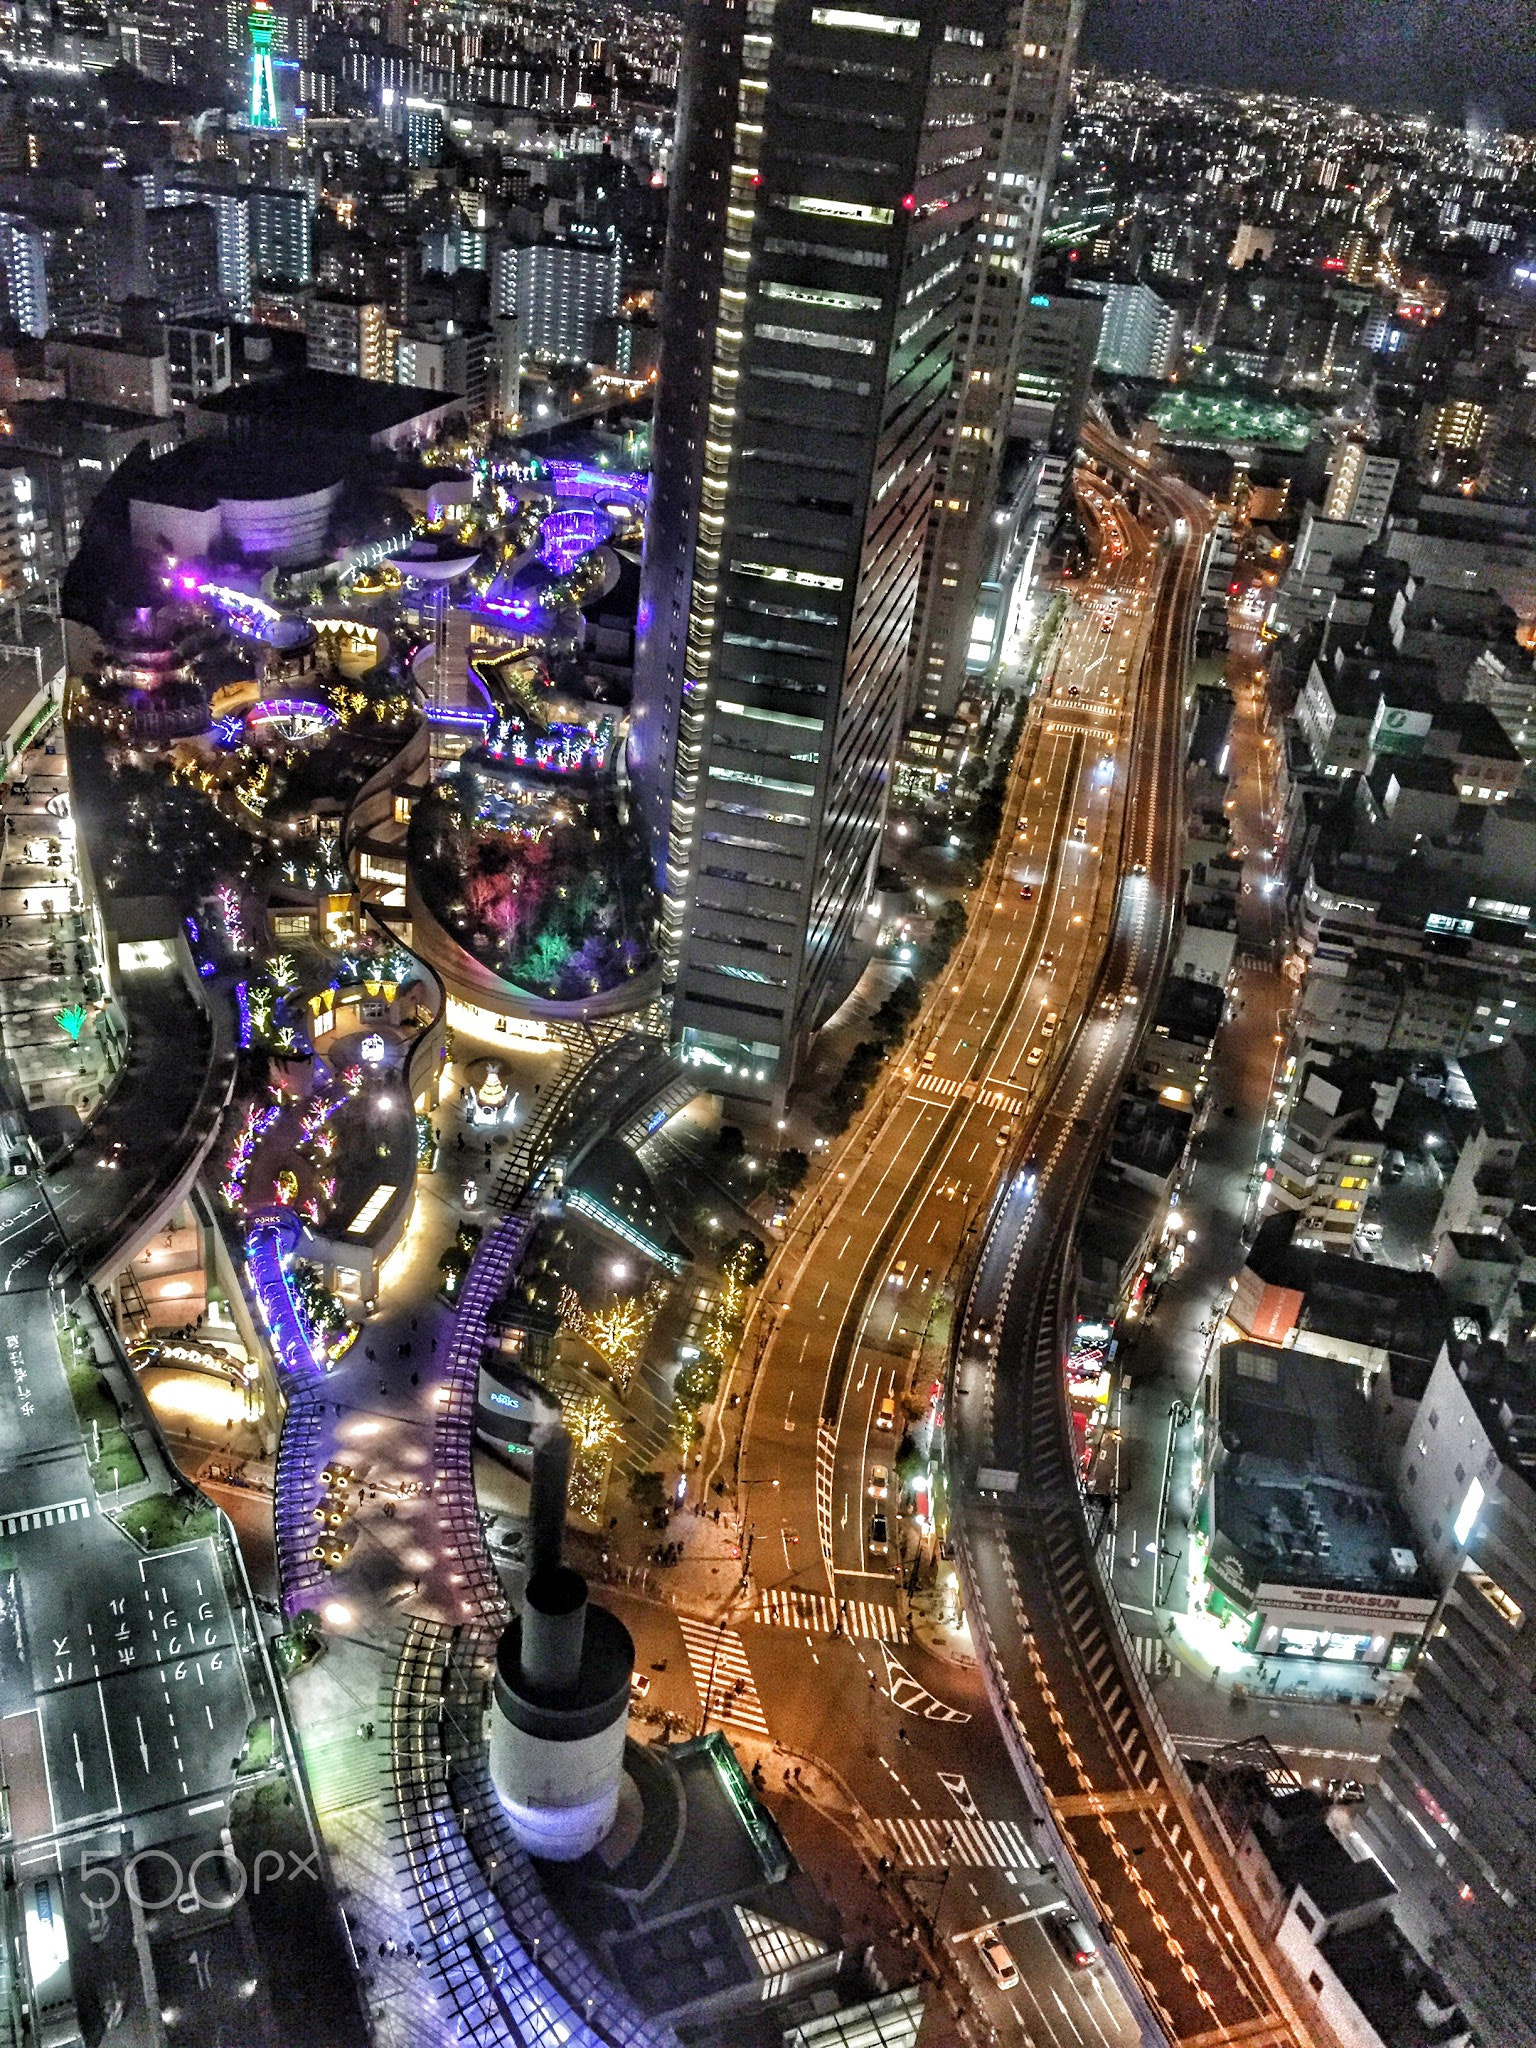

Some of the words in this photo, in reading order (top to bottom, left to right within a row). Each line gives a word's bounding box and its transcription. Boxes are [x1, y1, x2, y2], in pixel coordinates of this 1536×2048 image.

[109, 1597, 135, 1665] ホテル
[162, 1587, 188, 1680] タクシー
[196, 1578, 223, 1670] タクシー
[1324, 1592, 1400, 1609] SUN&SUN
[52, 1636, 73, 1683] バス
